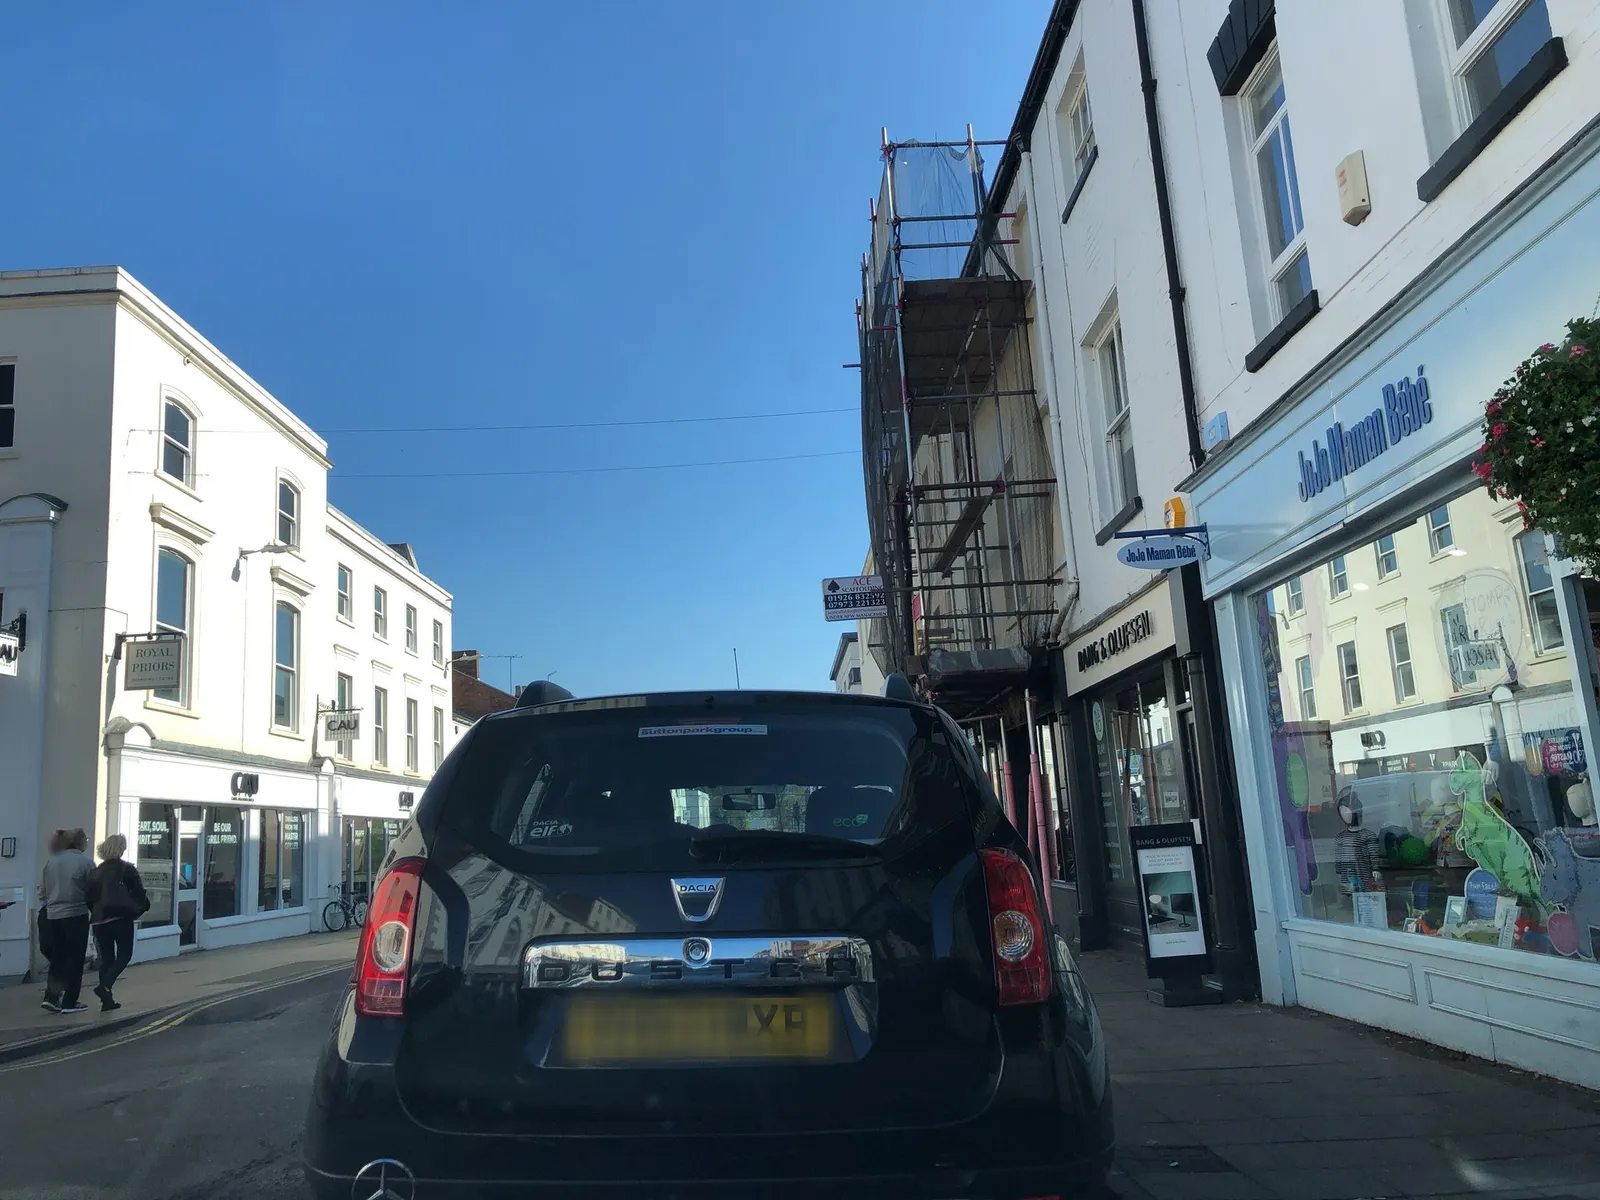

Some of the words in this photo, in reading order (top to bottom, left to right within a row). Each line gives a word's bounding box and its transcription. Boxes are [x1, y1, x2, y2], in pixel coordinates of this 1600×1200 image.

[1298, 439, 1331, 502] JoJo
[1326, 407, 1388, 482] Maman
[1382, 364, 1432, 446] Bébé
[1126, 547, 1145, 563] JoJo
[1146, 547, 1176, 562] Maman
[1176, 544, 1197, 559] Bébé
[852, 576, 872, 586] ACE
[841, 585, 885, 593] SCAFFOLDING
[827, 594, 853, 602] 01926
[855, 592, 885, 600] 832592
[828, 601, 853, 609] 07973
[856, 599, 886, 607] 221323
[1077, 640, 1100, 673] BANG
[1100, 636, 1108, 660] &
[1107, 610, 1151, 656] OLUFSEN
[135, 647, 173, 658] ROYAL
[132, 661, 175, 673] PRIORS
[327, 719, 358, 732] CAU
[530, 825, 558, 837] elf
[1136, 838, 1154, 846] BANG
[1161, 836, 1192, 844] OLUFSEN
[679, 884, 716, 892] DACIA
[537, 959, 857, 982] DUSTER
